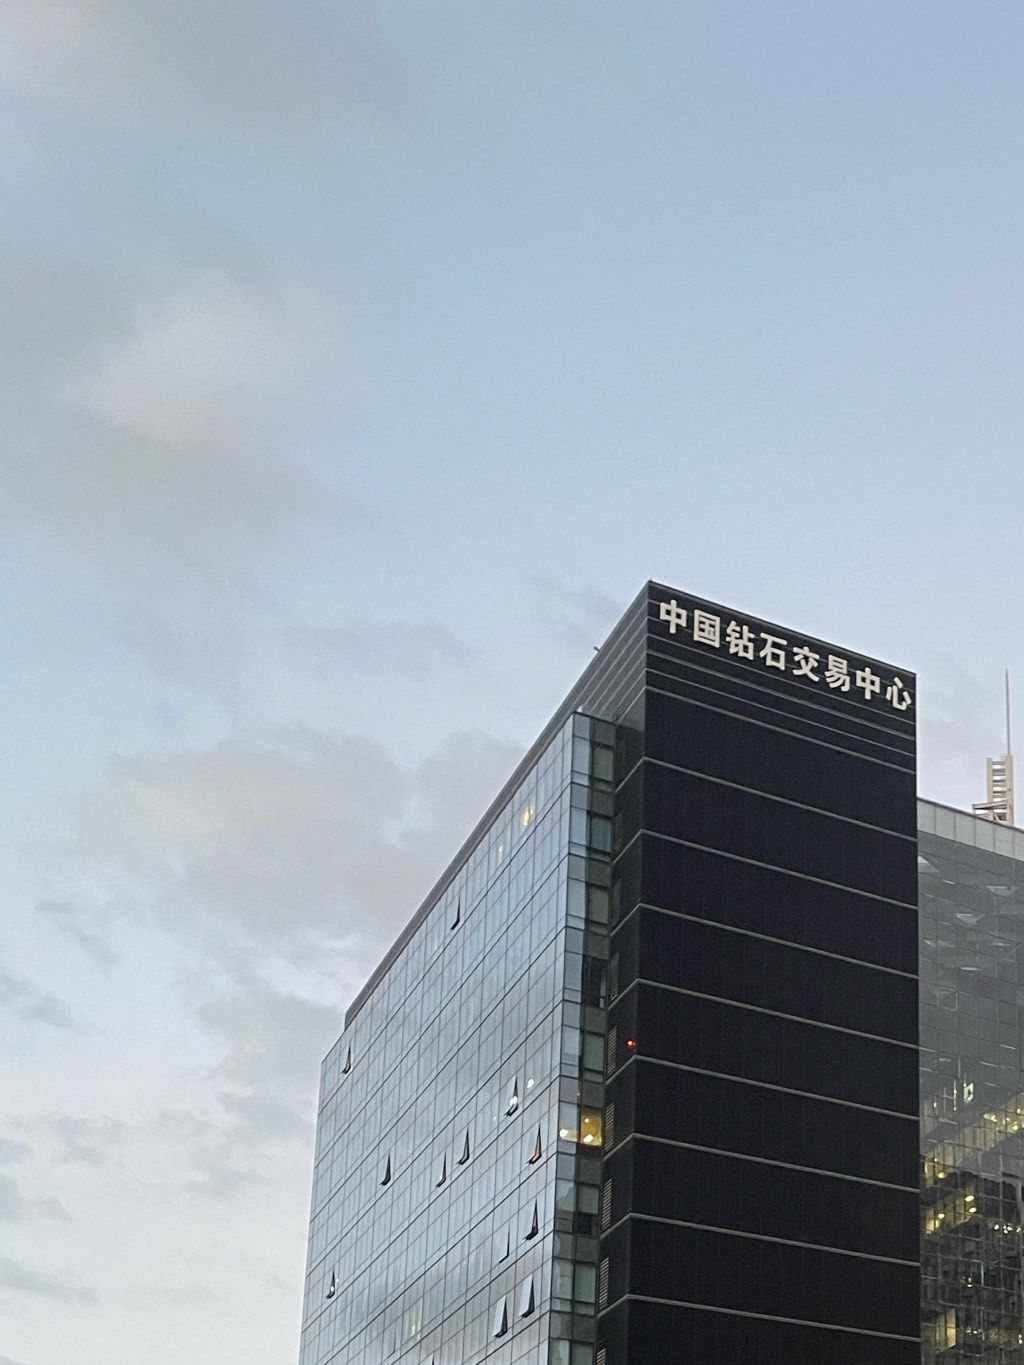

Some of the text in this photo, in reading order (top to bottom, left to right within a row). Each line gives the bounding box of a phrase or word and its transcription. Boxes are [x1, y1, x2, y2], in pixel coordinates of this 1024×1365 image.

[659, 599, 912, 711] 中国钻石交易中心
